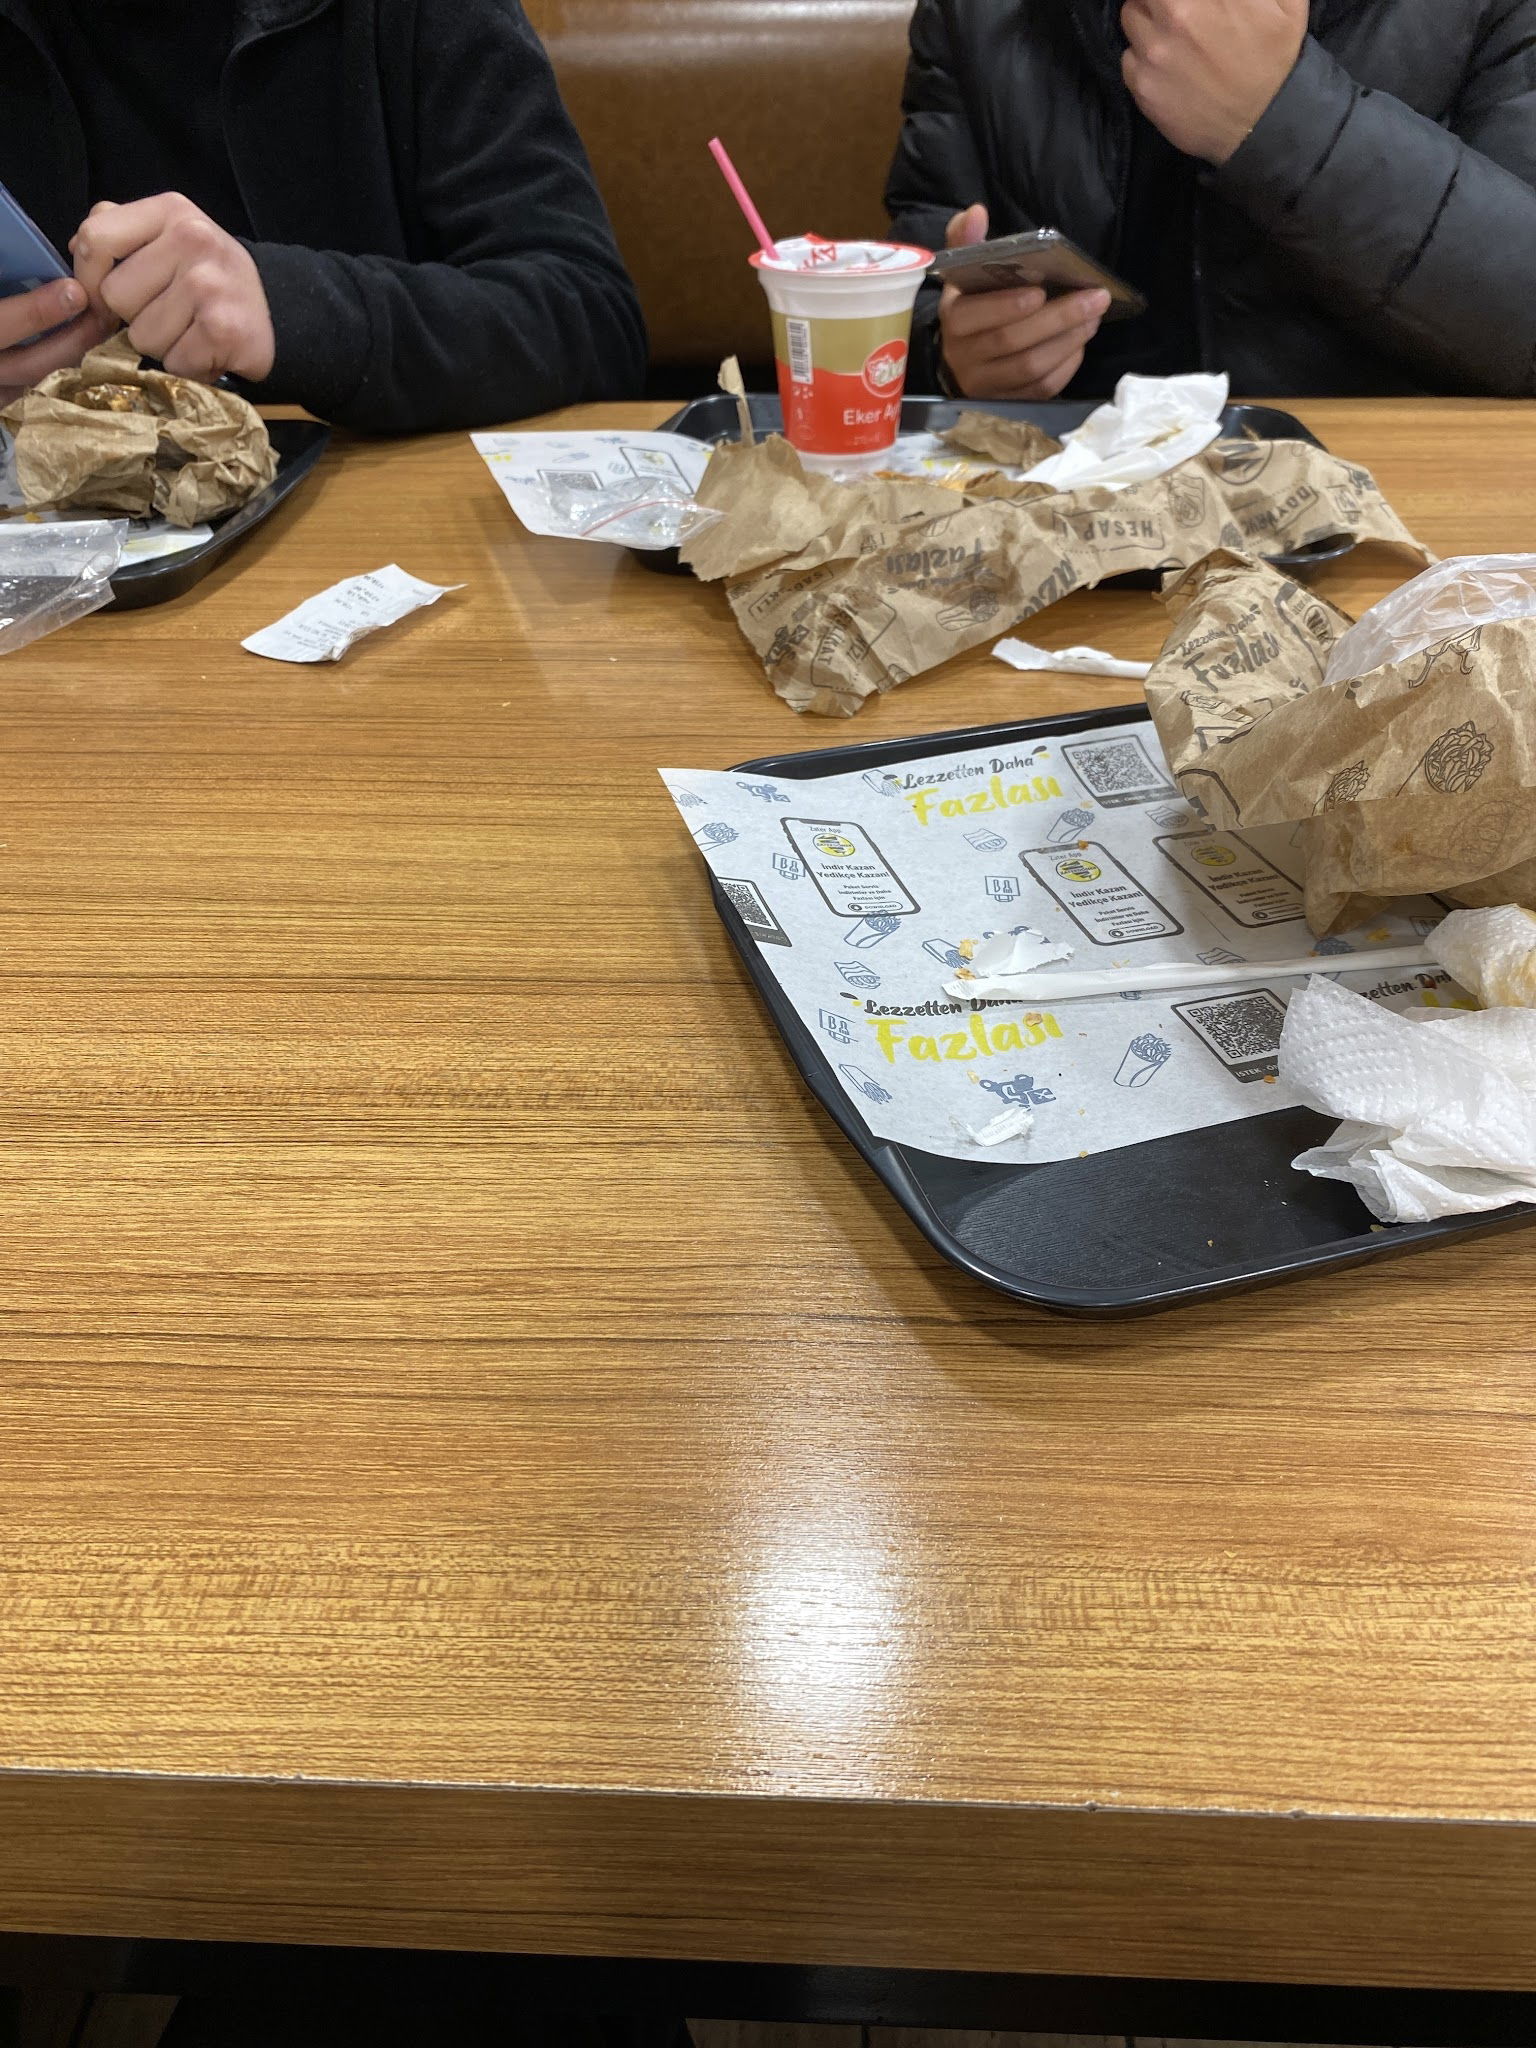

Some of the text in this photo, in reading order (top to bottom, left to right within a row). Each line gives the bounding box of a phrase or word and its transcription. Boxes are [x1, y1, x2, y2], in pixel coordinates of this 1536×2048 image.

[843, 406, 880, 425] Eker
[903, 756, 1034, 790] Lezzetten Daha
[904, 775, 1065, 826] Fazlası
[816, 871, 856, 879] Yedikçe
[1096, 885, 1127, 894] Kazan
[1068, 891, 1144, 908] Yedikçe Kazan!
[864, 999, 962, 1017] Lezzetten
[865, 1013, 1064, 1064] Fazlası
